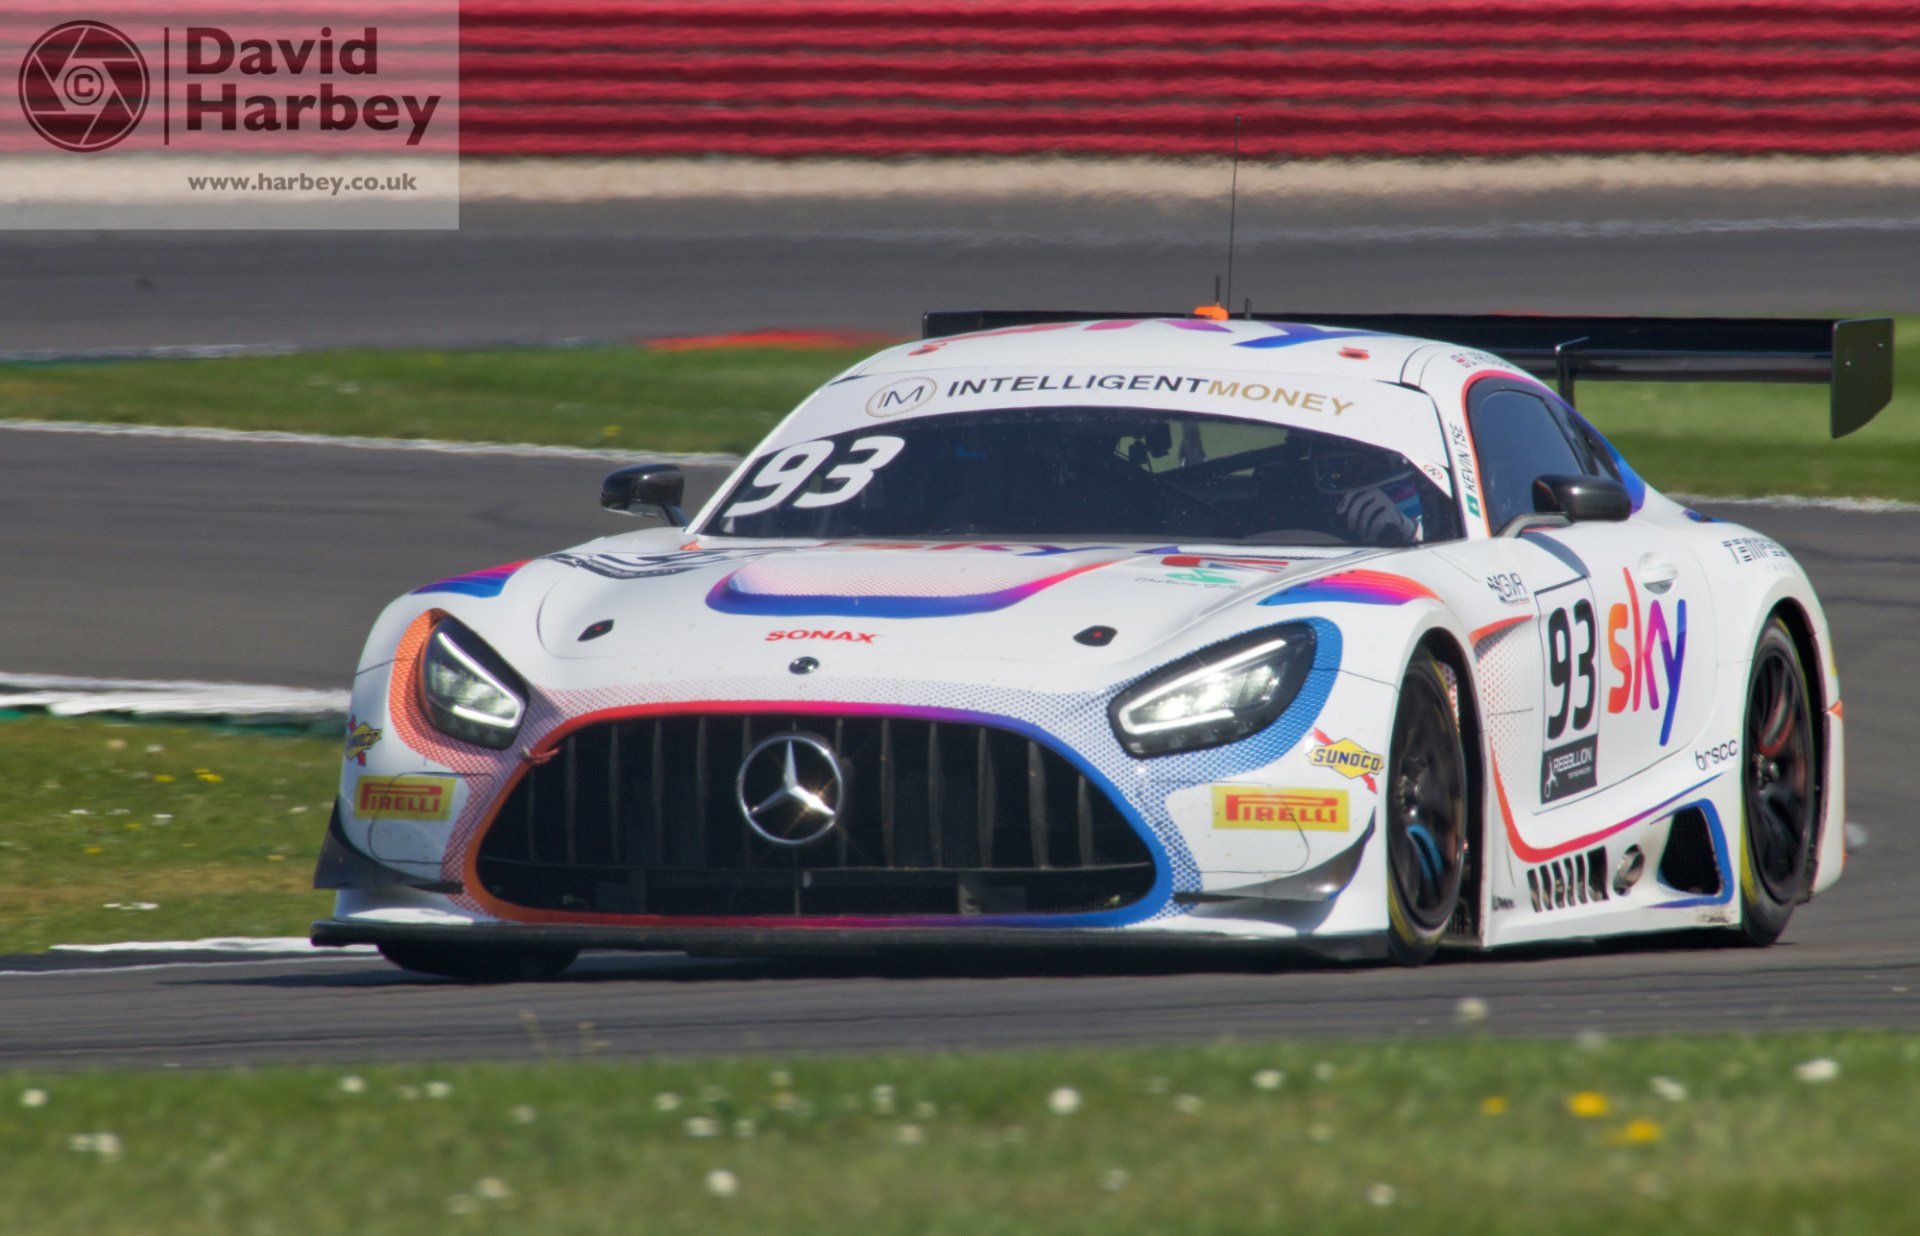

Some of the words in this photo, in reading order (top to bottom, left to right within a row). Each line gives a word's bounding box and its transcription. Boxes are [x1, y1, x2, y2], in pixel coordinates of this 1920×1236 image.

[1449, 422, 1467, 447] TSE
[723, 435, 905, 517] 93
[1457, 450, 1477, 493] KEVIN
[765, 629, 877, 644] SONAX
[1547, 598, 1597, 740] 93
[1607, 566, 1687, 746] sky
[1313, 748, 1381, 772] SUNOCO
[361, 782, 443, 813] PIRELLI
[1225, 794, 1339, 823] PIRELLI
